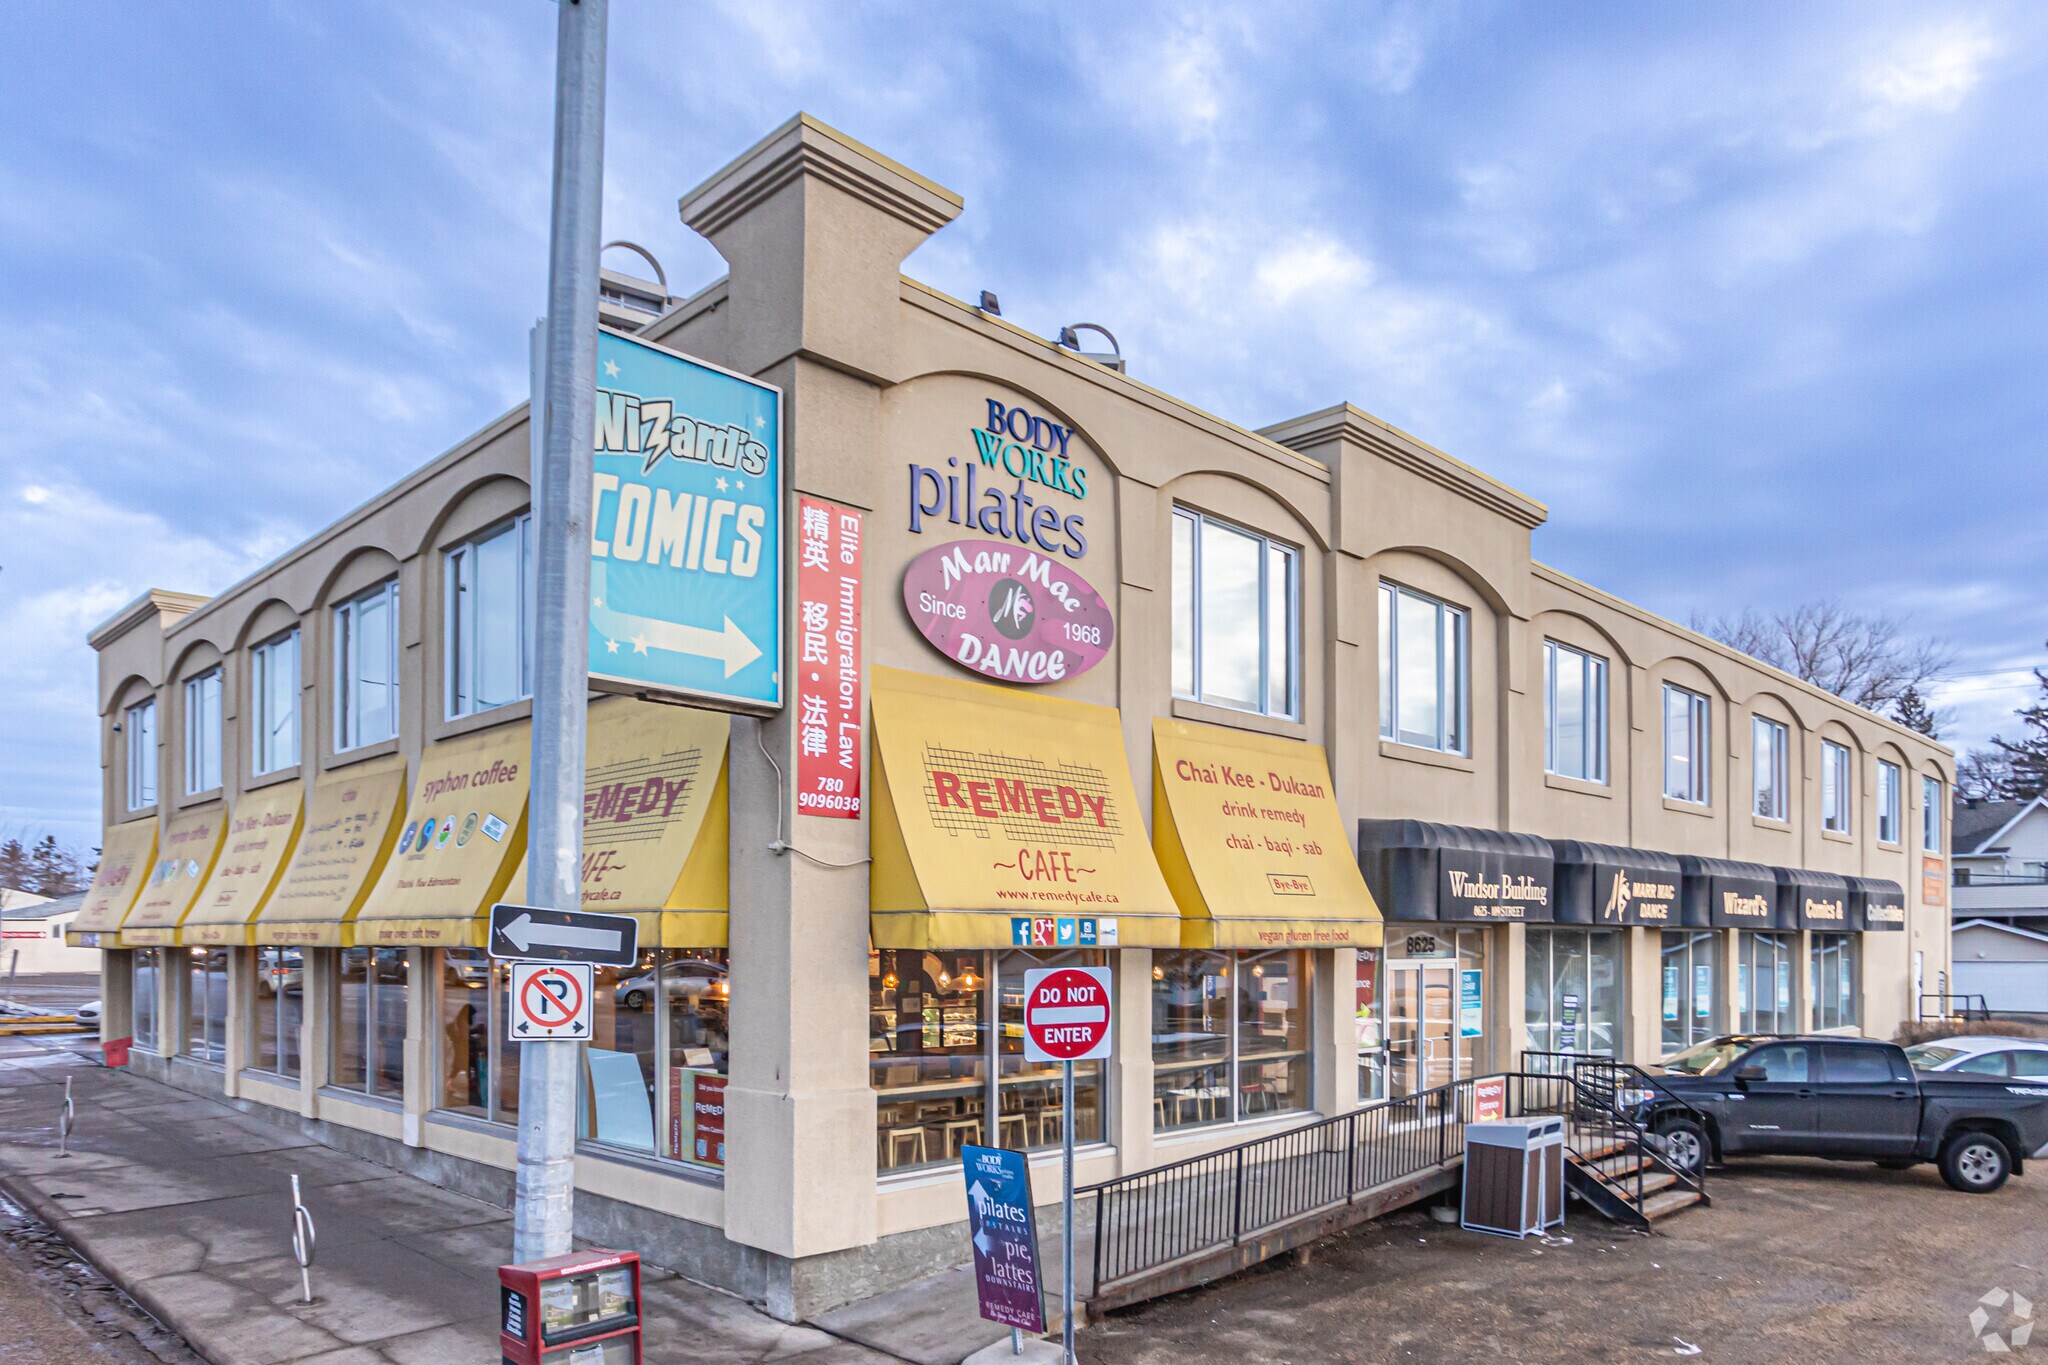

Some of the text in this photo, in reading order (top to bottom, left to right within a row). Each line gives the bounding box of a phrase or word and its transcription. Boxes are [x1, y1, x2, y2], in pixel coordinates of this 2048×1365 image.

[986, 398, 1074, 458] BODY
[972, 428, 1088, 499] WORKS
[909, 457, 1088, 558] pilates
[591, 473, 765, 578] COMICS
[840, 514, 858, 565] Elite
[941, 546, 1080, 613] Marr Mac
[919, 593, 1101, 645] Since 1968
[957, 633, 1066, 680] DANCE
[423, 760, 517, 803] syphon coffee
[817, 777, 843, 792] 780
[1176, 759, 1218, 785] Chai
[1221, 765, 1255, 789] Kee
[1268, 772, 1325, 799] Dukaan
[799, 792, 860, 811] 9096038
[932, 770, 1105, 827] REMEDY
[1222, 801, 1306, 828] drink remedy
[1226, 834, 1254, 850] chai
[1264, 836, 1292, 857] baqi
[1304, 841, 1323, 856] sab
[996, 889, 1119, 905] www.remedycafe.ca
[1273, 878, 1309, 893] Bye-Bye
[1449, 870, 1547, 905] Windsor Building
[1723, 892, 1767, 917] Wizard's
[1259, 931, 1284, 944] vegan
[1407, 937, 1435, 953] 8625
[1040, 987, 1096, 1003] DO NOT
[1044, 1027, 1092, 1044] ENTER
[696, 1102, 724, 1116] REMED
[982, 1154, 1001, 1165] BODY
[978, 1195, 1026, 1223] pilates
[980, 1219, 1028, 1235] UPSTAIRS
[1005, 1238, 1031, 1263] pie,
[991, 1257, 1033, 1285] lattes
[985, 1275, 1035, 1293] DOWNSTAIRS
[986, 1302, 1014, 1315] REMEDY
